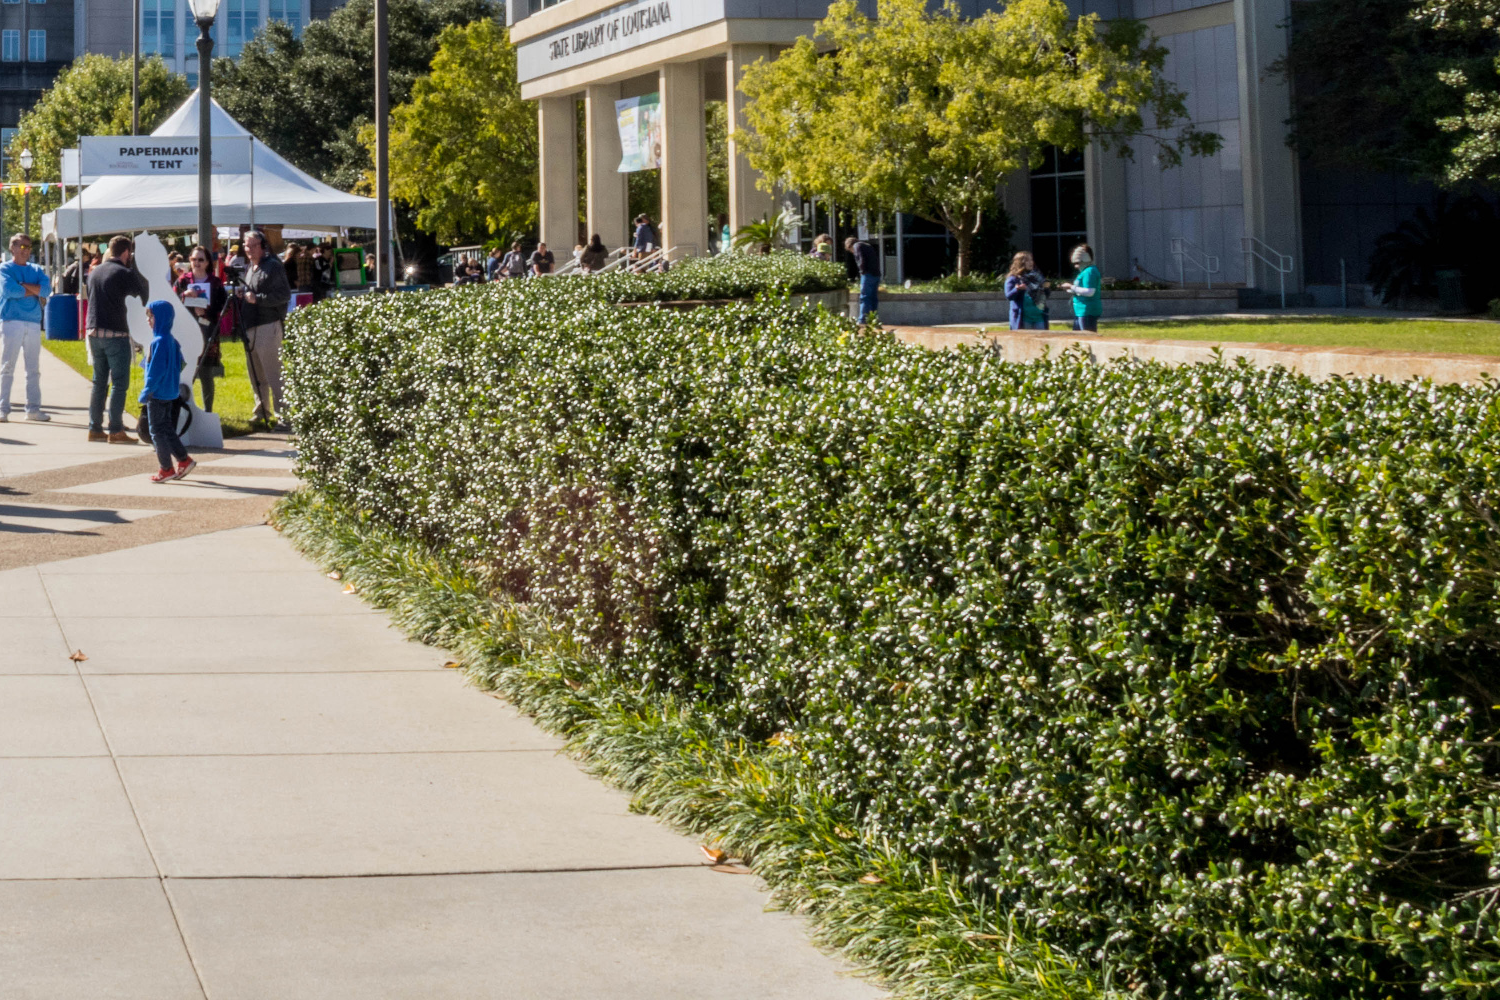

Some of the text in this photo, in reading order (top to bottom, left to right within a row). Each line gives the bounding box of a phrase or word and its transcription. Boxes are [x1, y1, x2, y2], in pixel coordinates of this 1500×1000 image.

[549, 1, 672, 60] STATE LIBRARY OF LOUISIANA
[119, 146, 212, 156] PAPERMAKIN
[149, 160, 183, 169] TENT
